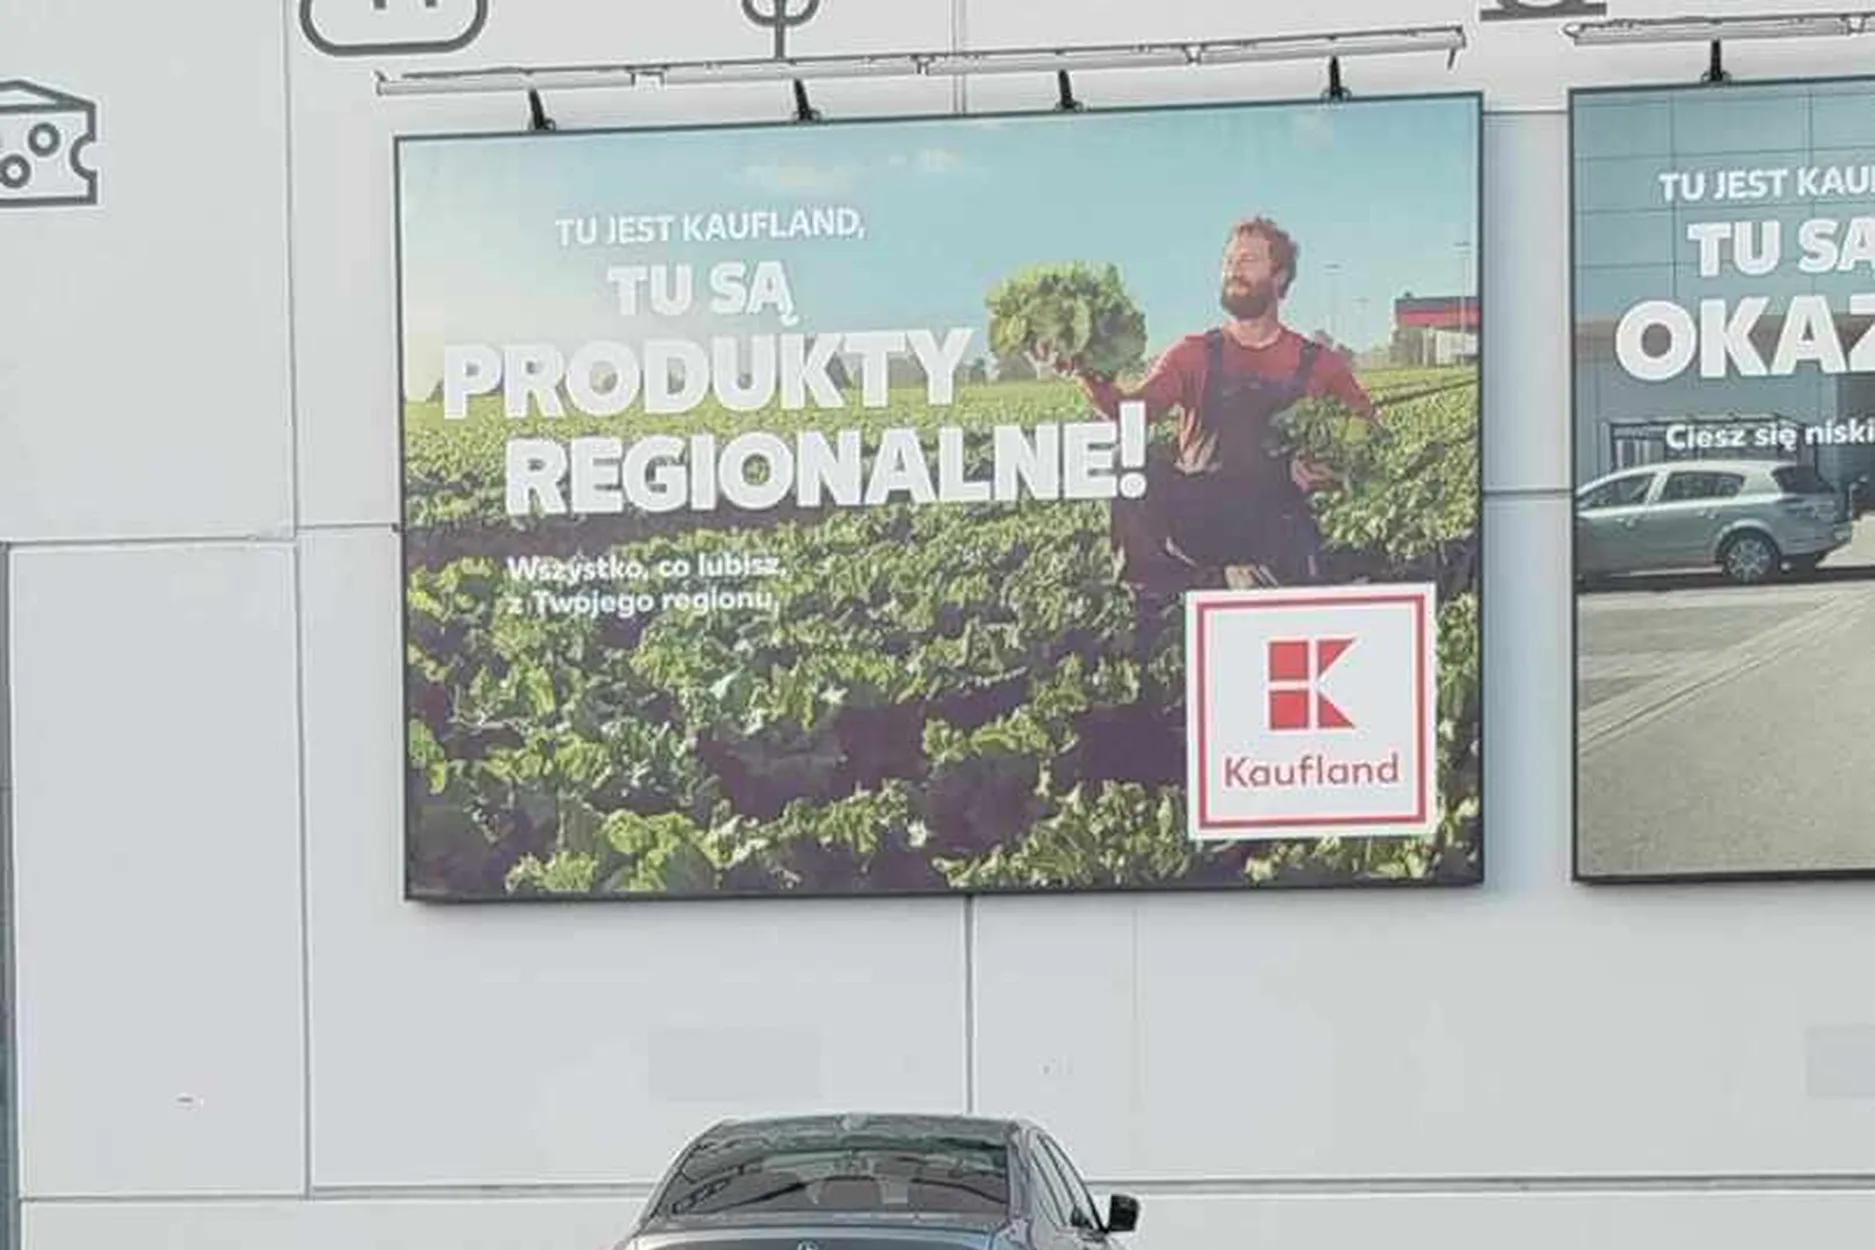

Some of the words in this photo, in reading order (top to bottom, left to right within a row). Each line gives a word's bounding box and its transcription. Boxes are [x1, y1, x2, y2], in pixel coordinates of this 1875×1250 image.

[1659, 172, 1705, 201] TU
[1714, 169, 1788, 199] JEST
[1797, 164, 1875, 197] KAU
[554, 216, 598, 245] TU
[606, 214, 674, 244] JEST
[682, 207, 866, 242] KAUFLAND,
[1687, 220, 1781, 277] TU
[606, 263, 692, 315] TU
[709, 260, 799, 326] SĄ
[443, 327, 975, 419] PRODUKTY
[1665, 424, 1746, 449] Ciesz
[1753, 421, 1797, 450] się
[505, 400, 1147, 515] REGIONALNE!
[507, 554, 648, 586] Wszystko,
[658, 558, 691, 577] co
[508, 597, 523, 614] z
[532, 590, 654, 618] Twojego
[1225, 753, 1398, 787] Kaufland
